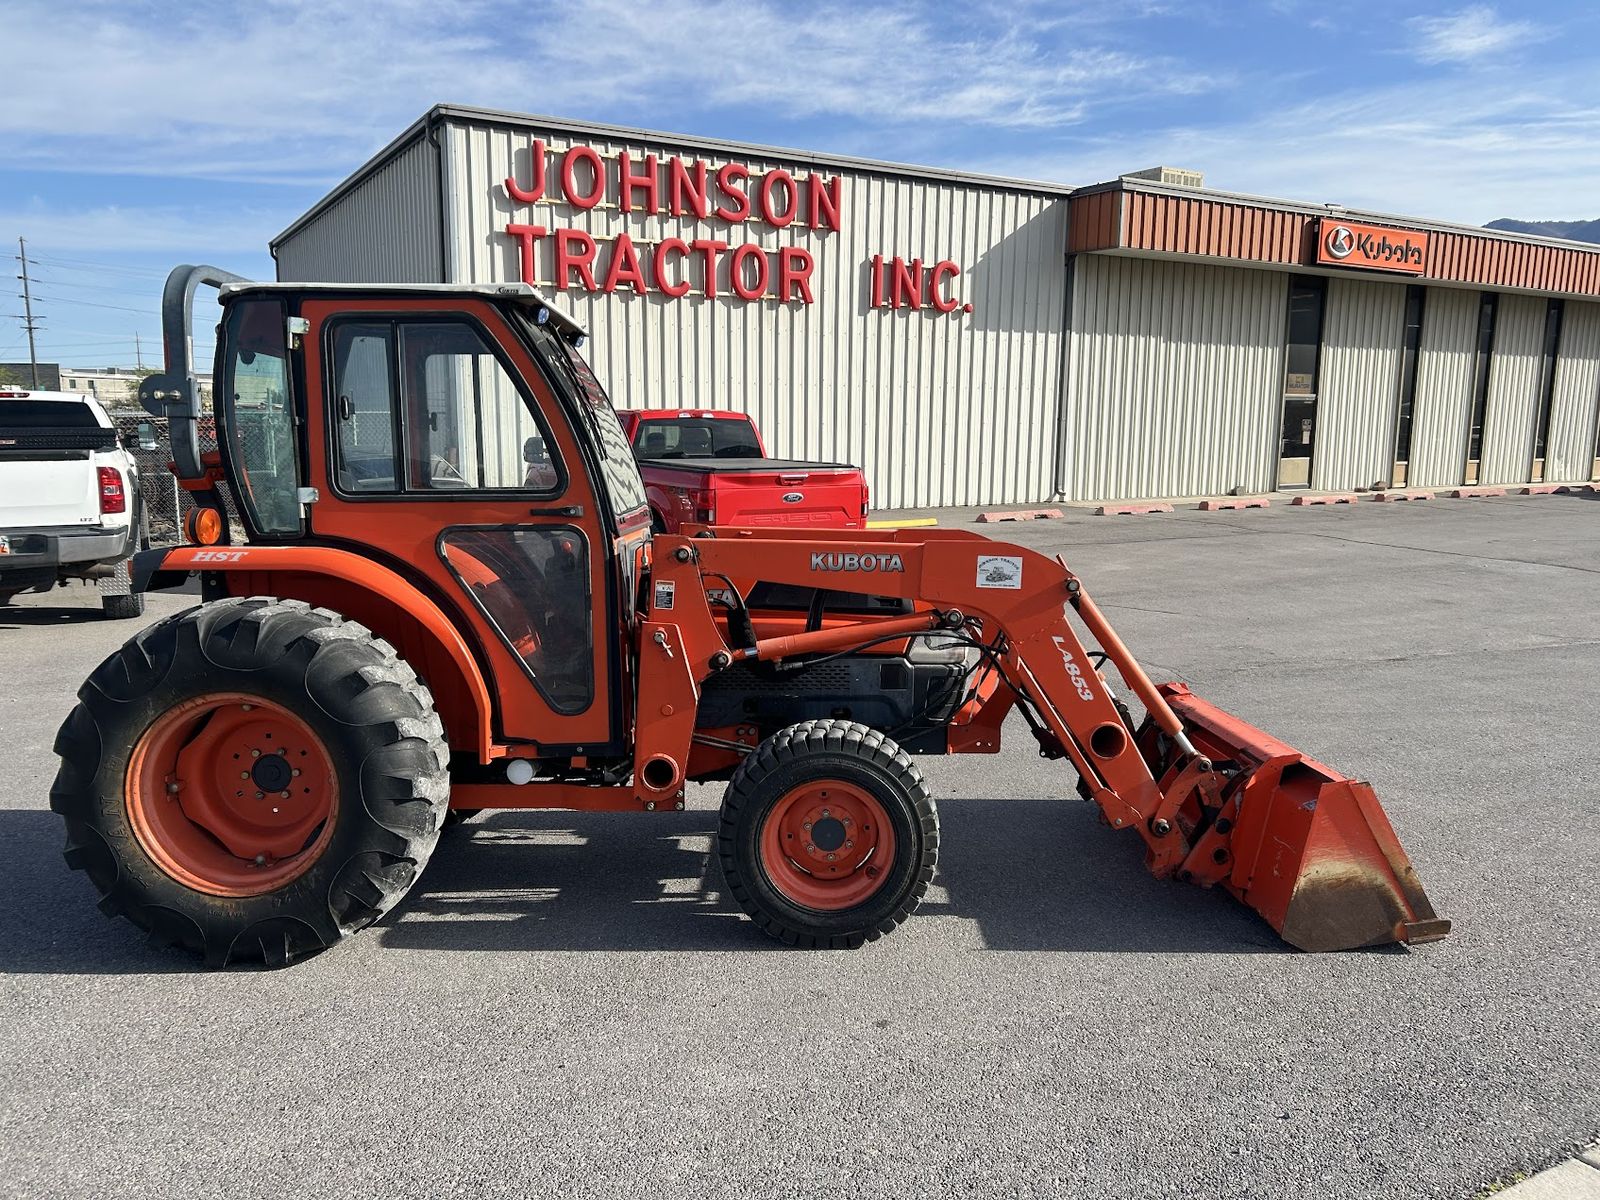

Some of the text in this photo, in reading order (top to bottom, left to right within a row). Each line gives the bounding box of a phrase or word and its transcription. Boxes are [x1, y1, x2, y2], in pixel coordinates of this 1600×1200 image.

[505, 139, 841, 232] JOHNSON
[506, 224, 974, 313] TRACTOR INC.
[1356, 232, 1422, 265] Kubota
[190, 551, 249, 562] HST
[810, 552, 904, 572] KUBOTA
[1051, 636, 1094, 701] LA853
